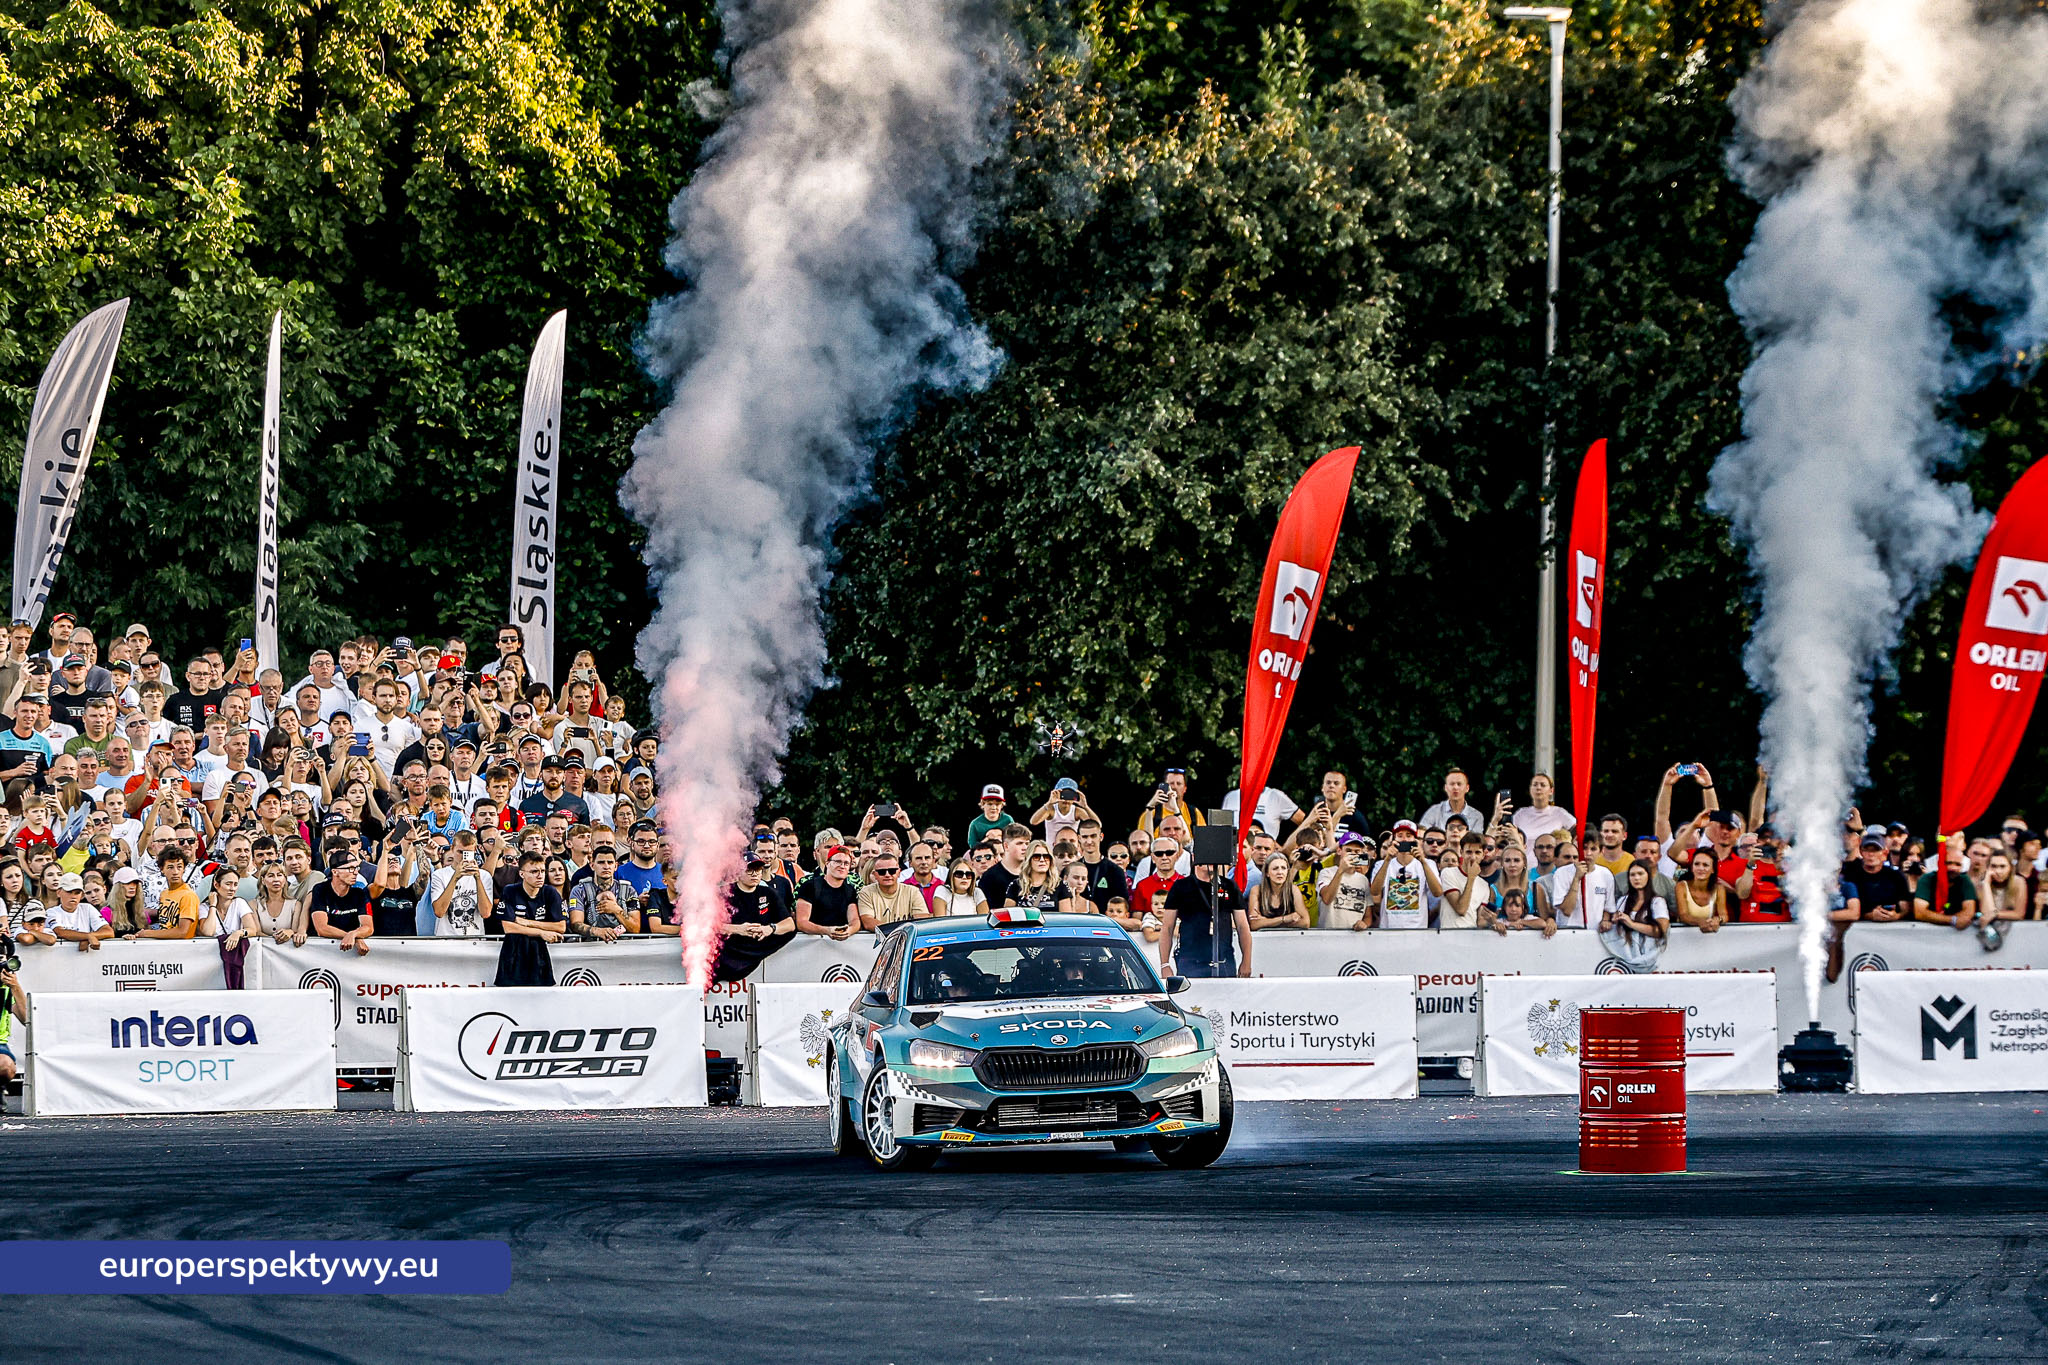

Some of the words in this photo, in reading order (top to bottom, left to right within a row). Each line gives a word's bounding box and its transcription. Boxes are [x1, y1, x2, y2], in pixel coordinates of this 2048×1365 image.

[1969, 641, 2047, 672] ORLEN
[1990, 672, 2021, 692] OIL
[913, 945, 944, 962] 22
[102, 964, 145, 976] STADION
[147, 961, 184, 979] ŚLĄSKI
[1230, 1010, 1339, 1027] Ministerstwo
[110, 1009, 259, 1049] interia
[503, 1027, 657, 1055] MOTO
[1230, 1032, 1286, 1051] Sportu
[1290, 1032, 1295, 1048] i
[1299, 1031, 1376, 1051] Turystyki
[138, 1058, 235, 1083] SPORT
[500, 1058, 645, 1078] WIZJA
[1616, 1083, 1656, 1094] ORLEN
[1617, 1095, 1633, 1103] OIL
